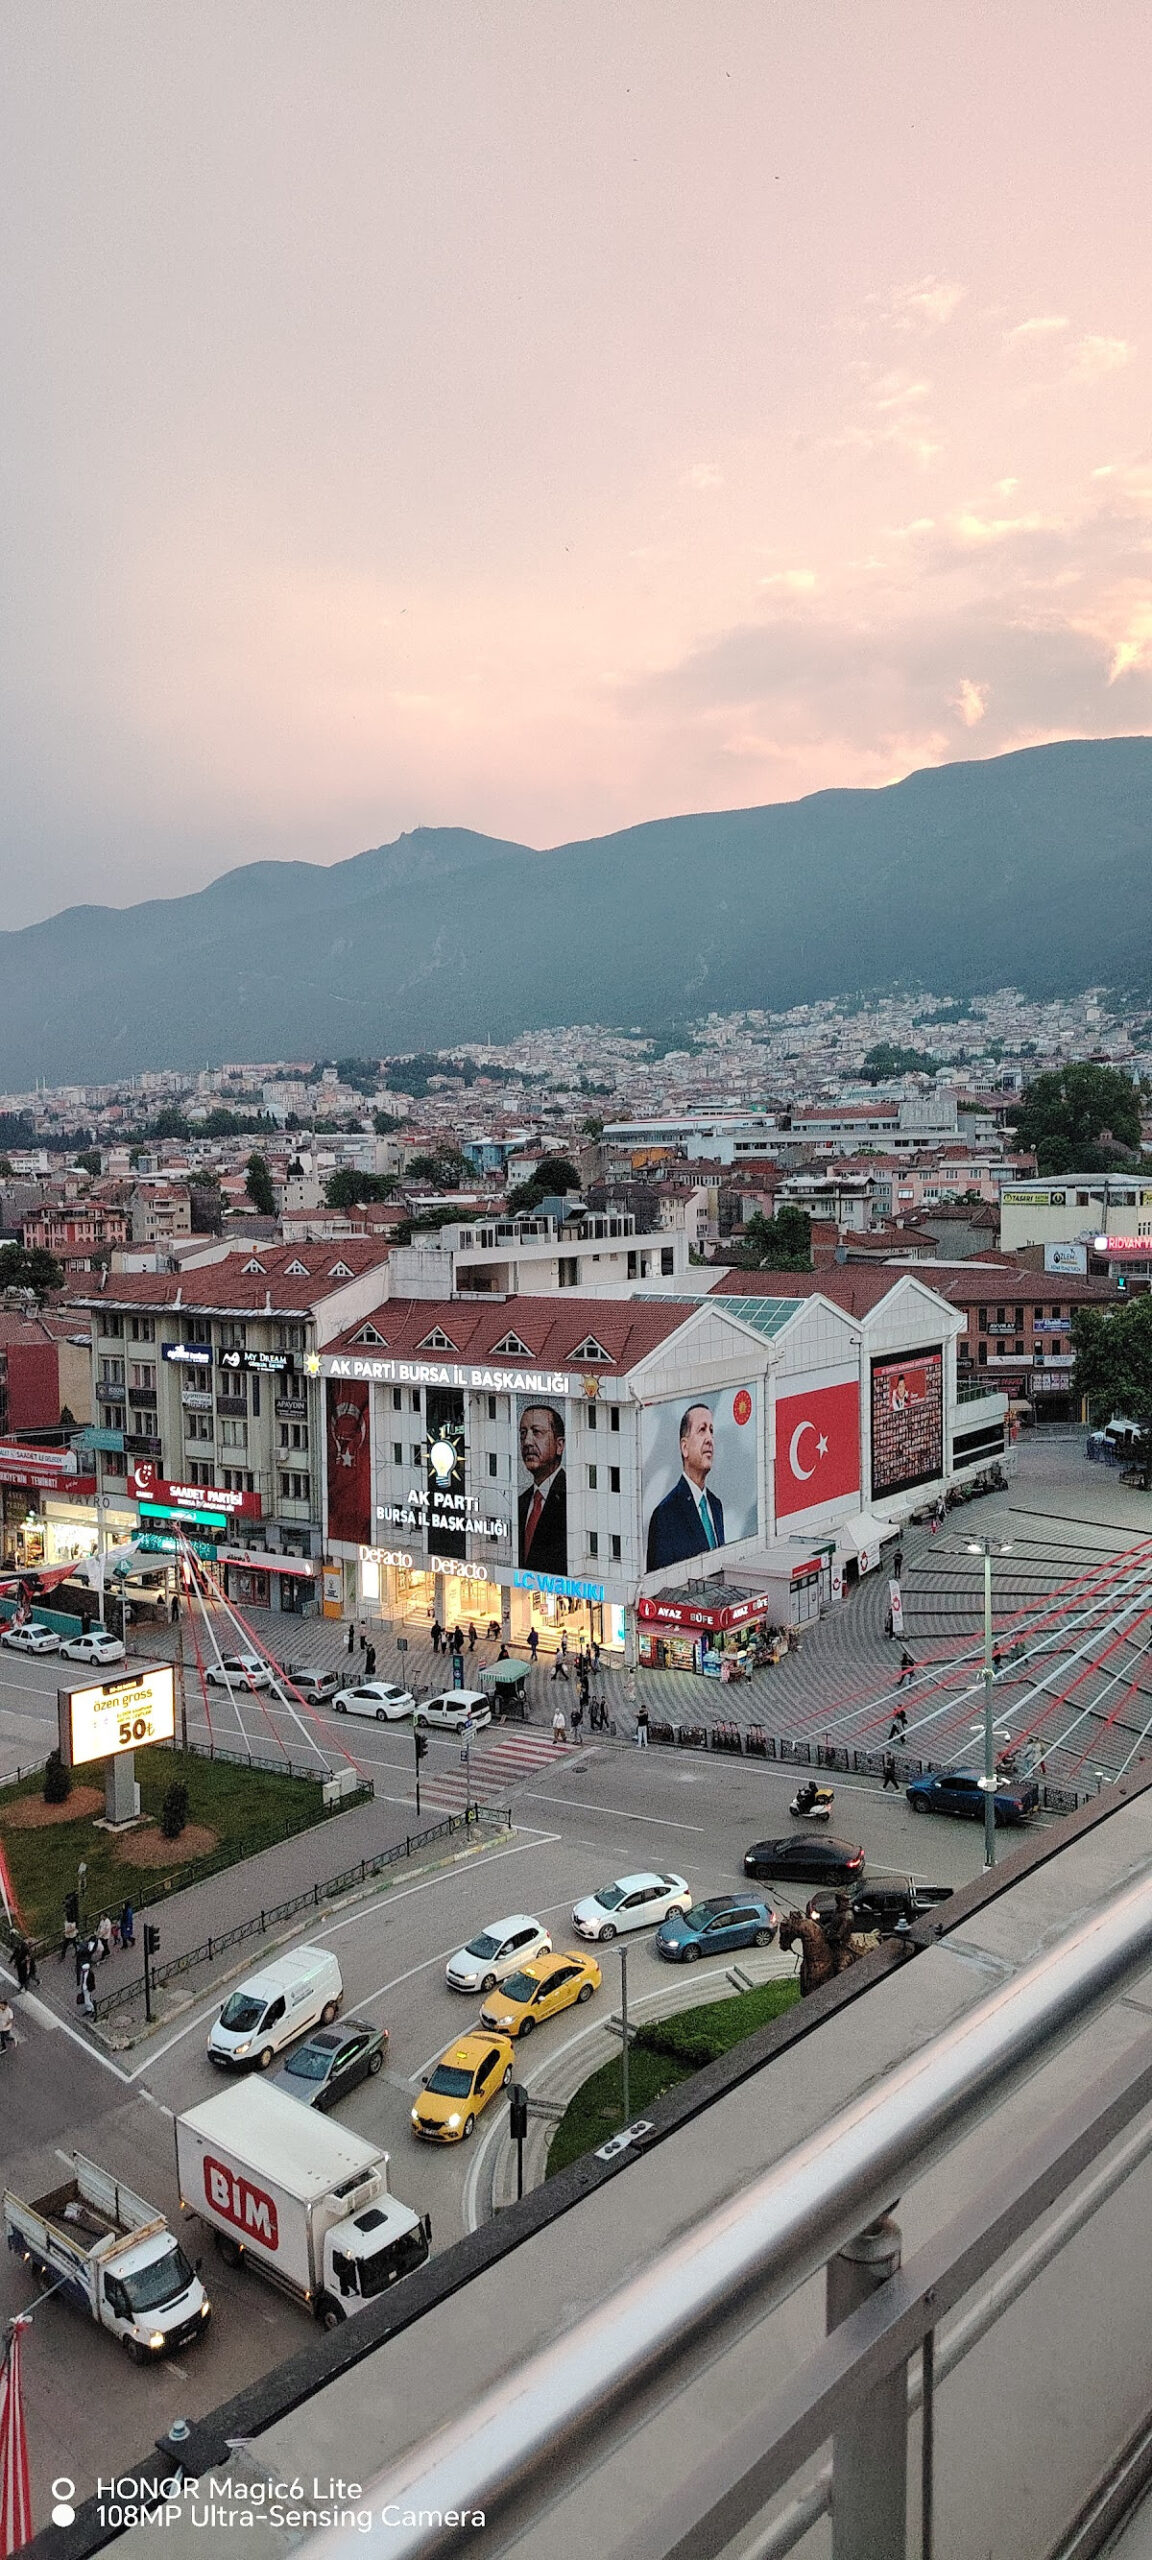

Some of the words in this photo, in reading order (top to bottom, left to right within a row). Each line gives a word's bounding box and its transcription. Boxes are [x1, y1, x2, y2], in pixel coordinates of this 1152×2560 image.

[244, 1352, 257, 1361] MY
[260, 1353, 287, 1364] DREAM
[330, 1360, 350, 1376] AK
[354, 1360, 395, 1380] PARTİ
[399, 1364, 450, 1384] BURSA
[454, 1364, 467, 1385] İL
[472, 1371, 569, 1394] BAŞKANLIĞI
[169, 1485, 205, 1501] SAADET
[407, 1489, 430, 1507] AK
[376, 1506, 416, 1525] BURSA
[432, 1513, 508, 1538] BAŞKANLIĞI
[359, 1544, 413, 1569] DeFacto
[431, 1555, 488, 1581] DeFacto
[513, 1570, 535, 1591] LC
[658, 1607, 682, 1620] AYAZ
[690, 1612, 714, 1626] BÜFE
[732, 1605, 749, 1620] AYAZ
[93, 1697, 120, 1713] özen
[122, 1688, 153, 1709] gross
